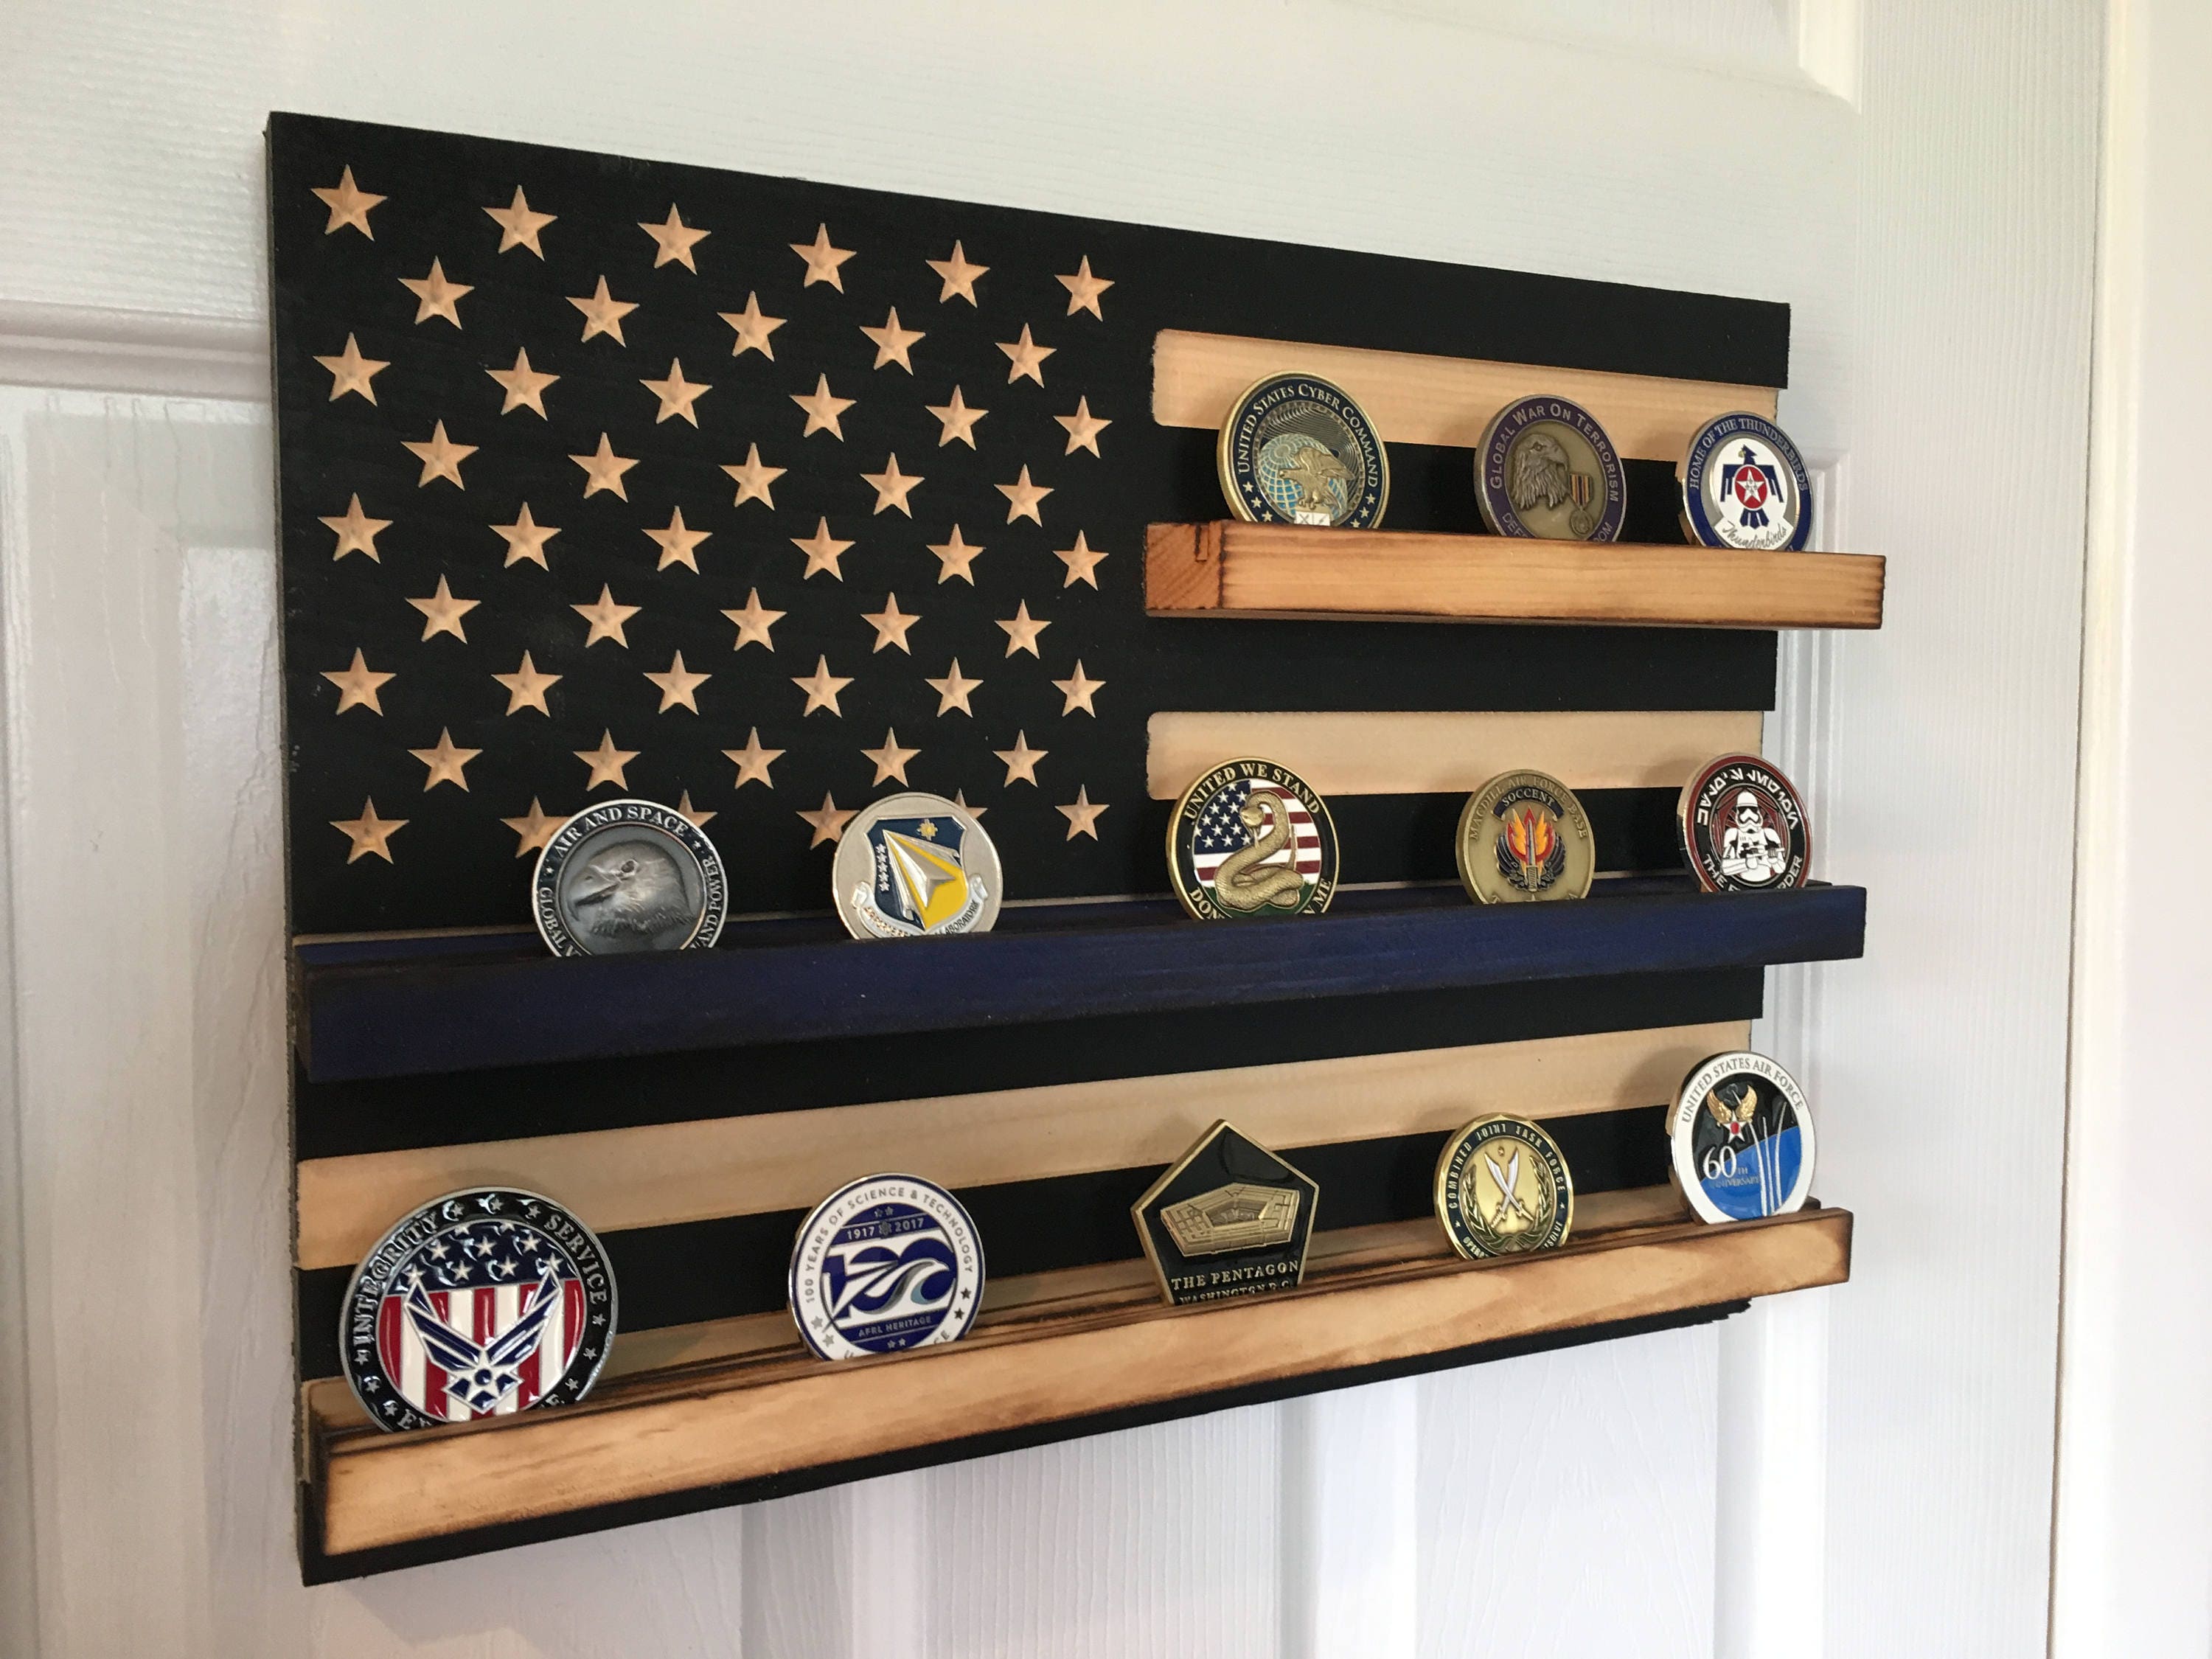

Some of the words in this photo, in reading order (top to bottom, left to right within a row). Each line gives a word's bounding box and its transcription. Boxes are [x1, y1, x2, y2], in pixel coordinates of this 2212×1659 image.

[1237, 414, 1257, 474] UNITED
[1253, 385, 1295, 415] STATES
[1298, 383, 1341, 410] CYBER
[1343, 406, 1379, 488] COMMAND
[1489, 426, 1515, 490] GLOBAL
[1512, 406, 1545, 425] WAR
[1550, 403, 1571, 421] ON
[1577, 413, 1618, 502] TERRORISM
[1690, 444, 1707, 490] HOME
[1702, 432, 1718, 448] OF
[1714, 419, 1739, 437] THE
[1739, 418, 1809, 491] THUNDERBIRDS
[1722, 520, 1787, 549] Thunderbirds
[1184, 766, 1237, 820] UNITED
[1240, 762, 1267, 777] WE
[1272, 768, 1320, 815] STAND
[1470, 785, 1505, 840] MACDILL
[1507, 776, 1529, 787] AIR
[1532, 776, 1568, 804] FORCE
[1568, 806, 1587, 839] BASE
[1501, 787, 1556, 807] SOCCENT
[553, 827, 583, 858] AIR
[585, 807, 622, 829] AND
[627, 806, 689, 838] SPACE
[703, 855, 723, 912] POWER
[1703, 854, 1728, 889] THE
[539, 886, 567, 949] GLOBAL
[1683, 1072, 1713, 1123] UNITED
[1714, 1057, 1750, 1077] STATES
[1753, 1059, 1773, 1077] AIR
[1773, 1071, 1804, 1110] FORCE
[1447, 1141, 1473, 1209] COMBINED
[1476, 1124, 1507, 1141] JOINT
[1515, 1125, 1543, 1148] TASK
[1545, 1152, 1566, 1192] FORCE
[1703, 1146, 1737, 1180] 60
[828, 1208, 849, 1227] OF
[848, 1187, 905, 1210] SCIENCE
[910, 1190, 917, 1200] &
[805, 1230, 829, 1271] YEARS
[847, 1225, 876, 1240] 1917
[894, 1218, 925, 1232] 2017
[923, 1194, 973, 1273] TECHNOLOGY
[352, 1211, 438, 1346] INTEGRITY
[543, 1213, 608, 1305] SERVICE
[1171, 1274, 1206, 1290] THE
[1211, 1261, 1299, 1284] PENTAGON
[805, 1279, 815, 1303] 100
[858, 1325, 883, 1338] AFRL
[885, 1315, 932, 1332] HERITAGE
